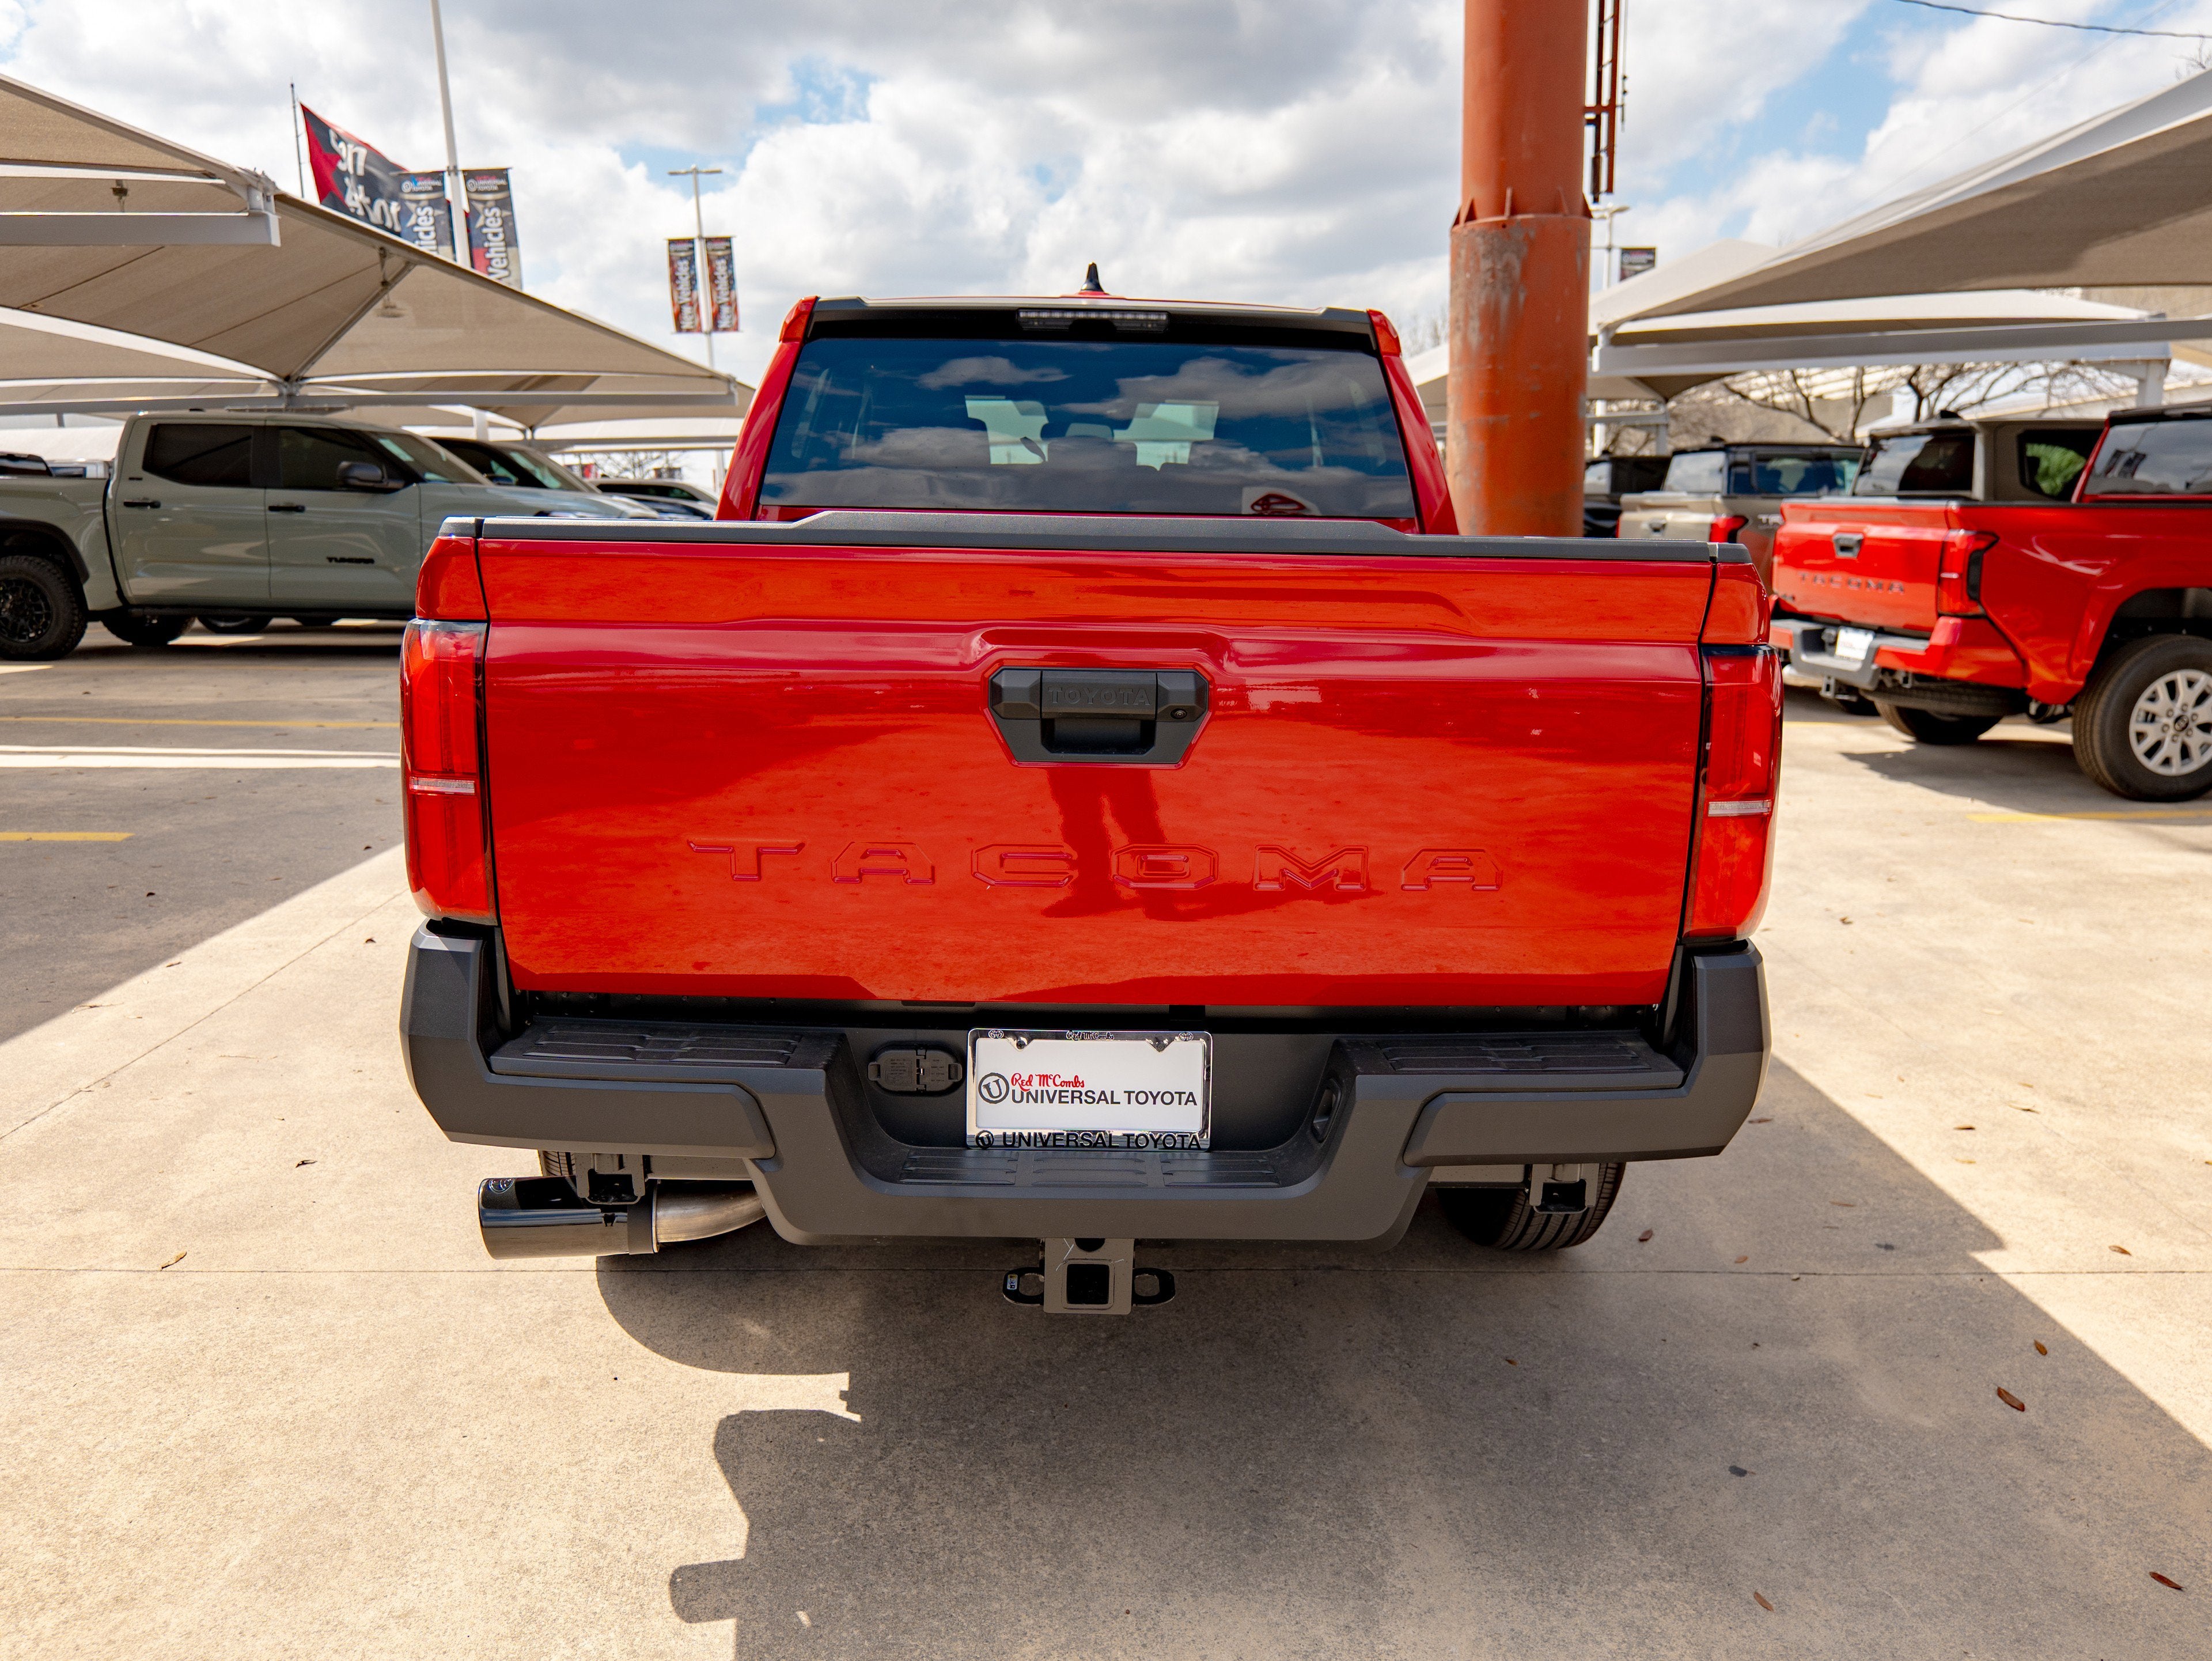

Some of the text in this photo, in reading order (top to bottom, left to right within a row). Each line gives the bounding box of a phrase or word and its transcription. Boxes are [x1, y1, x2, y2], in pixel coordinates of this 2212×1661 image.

[481, 206, 511, 279] Vehicles
[675, 259, 691, 305] Vehicles
[714, 259, 730, 305] Vehicles
[1798, 570, 1904, 595] TACOMA
[1047, 686, 1152, 706] TOYOTA
[687, 838, 1503, 891] TACOMA
[1066, 1030, 1082, 1041] Red
[1011, 1073, 1085, 1092] Red McCombs
[1012, 1089, 1197, 1106] UNIVERSAL TOYOTA
[1002, 1132, 1119, 1148] UNIVERSAL
[1122, 1133, 1202, 1149] TOYOTA
